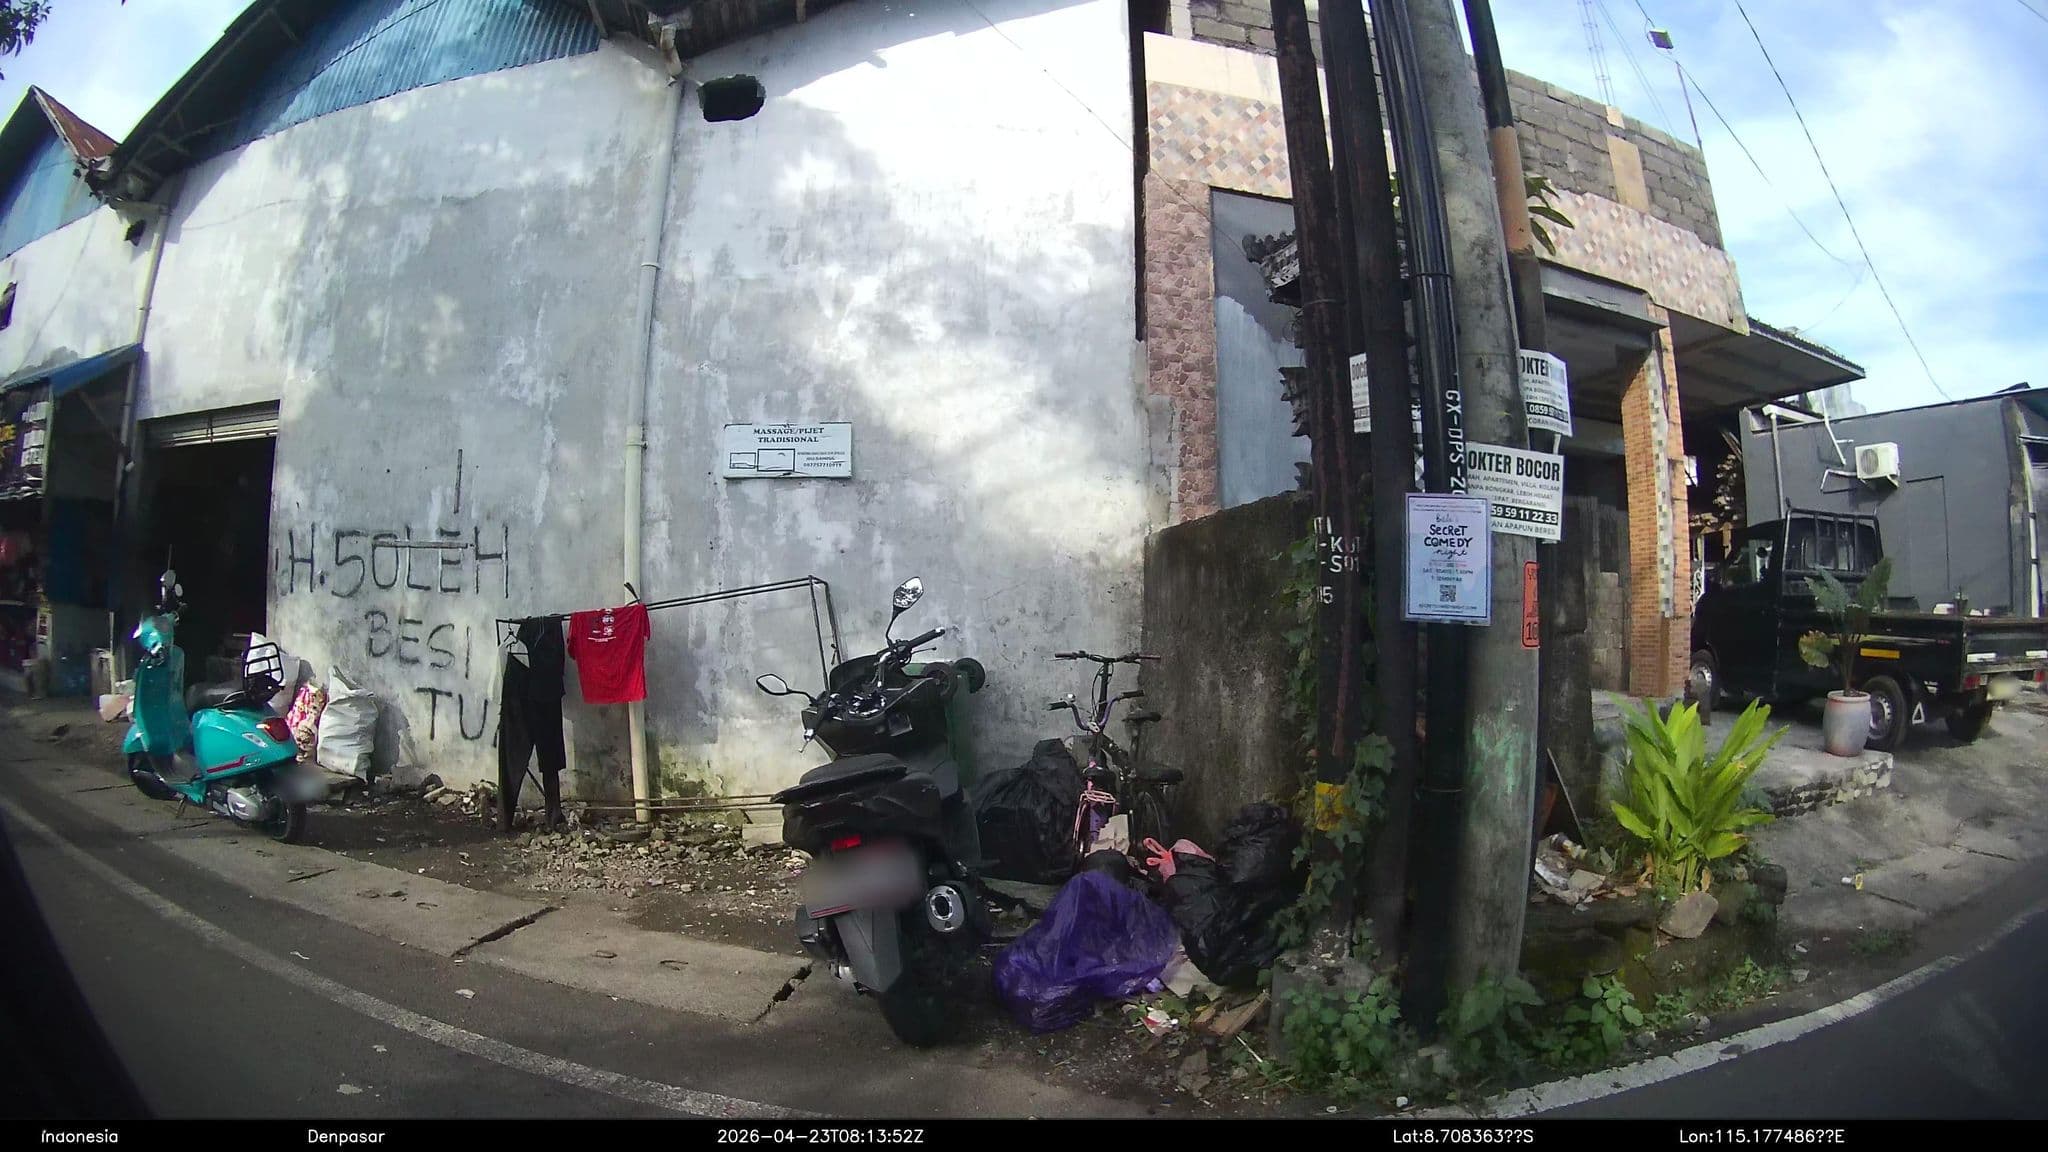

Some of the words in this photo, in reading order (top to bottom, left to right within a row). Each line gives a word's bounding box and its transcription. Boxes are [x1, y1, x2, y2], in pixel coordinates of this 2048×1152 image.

[758, 436, 819, 444] TRADISIONAL
[1516, 457, 1560, 482] BOCOR
[1505, 507, 1517, 518] 59
[1519, 508, 1530, 520] 11
[1532, 511, 1544, 522] 22
[1545, 513, 1558, 524] 33
[1504, 522, 1534, 533] APAPUN
[1424, 536, 1473, 548] COMEDY
[364, 610, 471, 680] BESI
